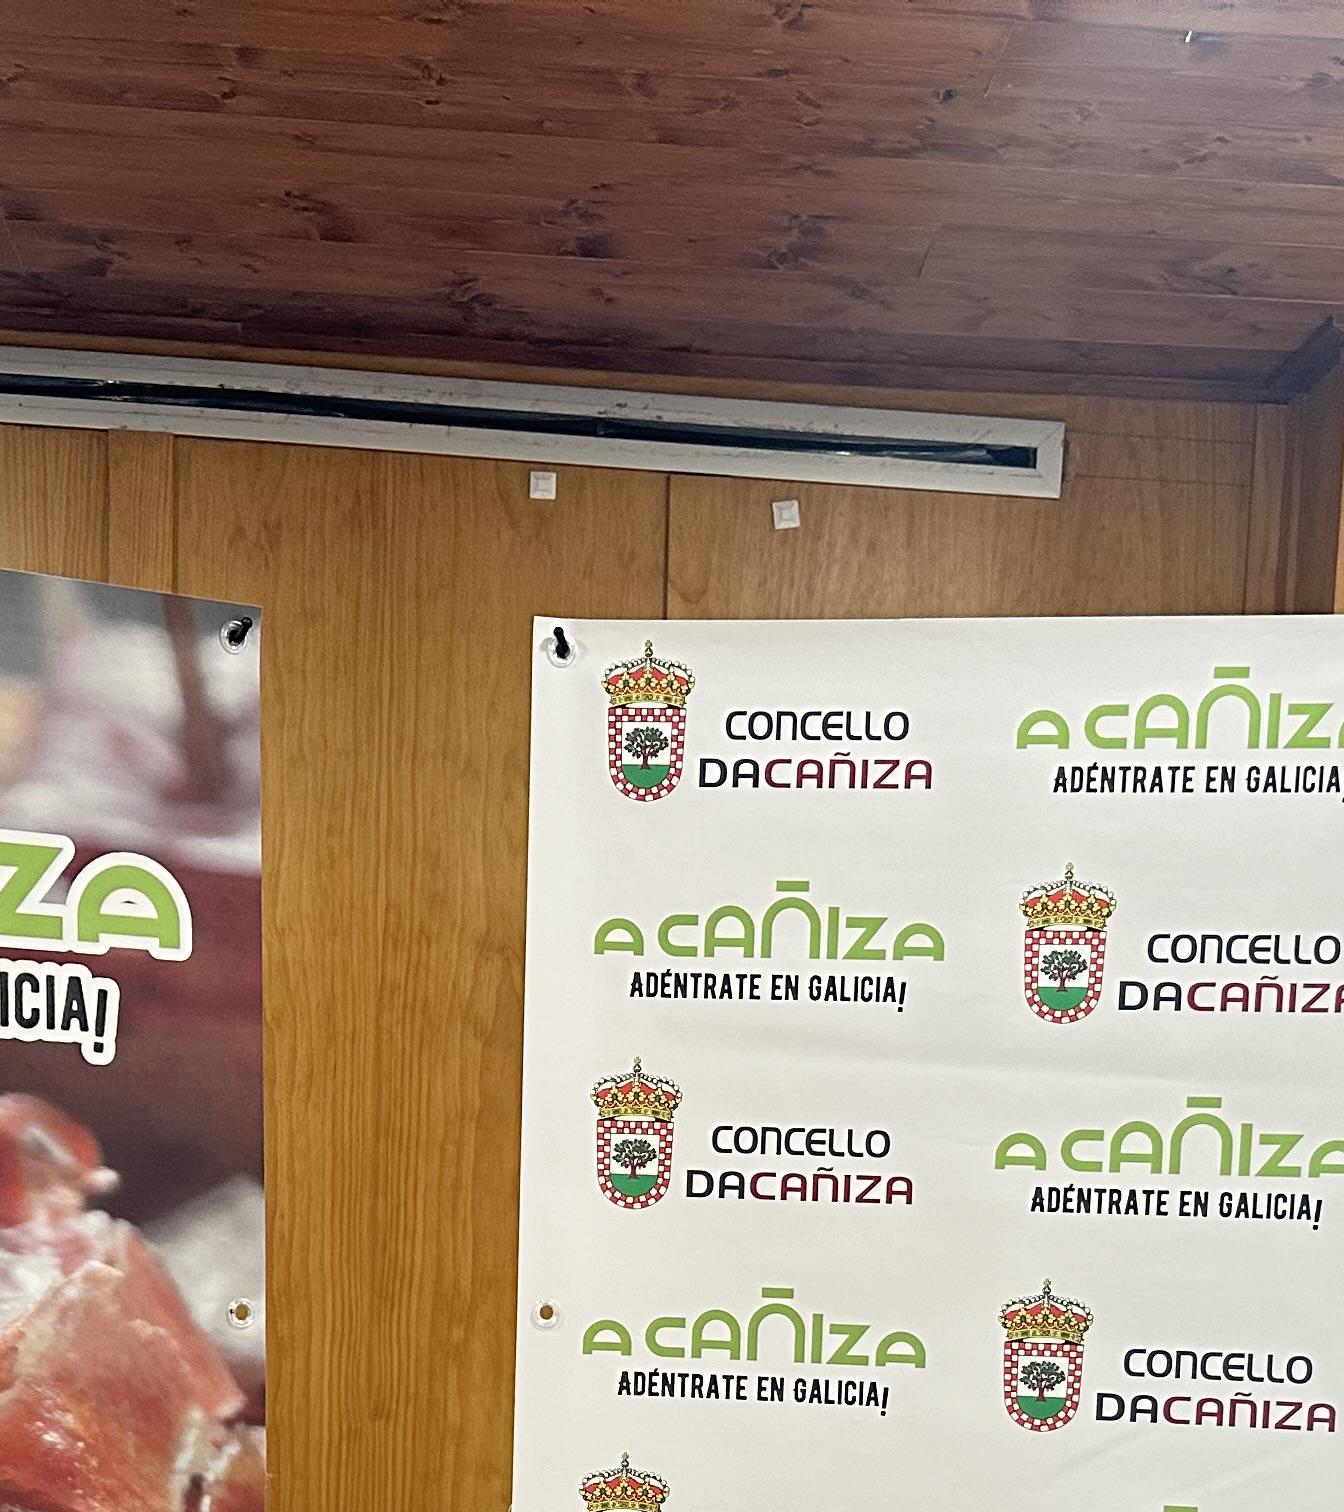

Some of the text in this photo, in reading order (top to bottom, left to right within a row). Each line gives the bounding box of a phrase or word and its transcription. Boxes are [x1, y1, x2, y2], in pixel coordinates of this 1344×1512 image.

[725, 709, 909, 742] CONCELLO
[1016, 708, 1069, 749] A
[1053, 762, 1195, 795] ADÉNTRATE
[1204, 765, 1235, 795] EN
[594, 880, 945, 962] A CAÑIZA
[1147, 933, 1342, 966] CONCELLO
[630, 968, 762, 1002] ADÉNTRATE
[770, 973, 800, 1002] EN
[711, 1125, 891, 1158] CONCELLO
[994, 1130, 1048, 1171] A
[1030, 1185, 1169, 1217] ADÉNTRATE
[1179, 1189, 1210, 1219] EN
[581, 1287, 927, 1368] A CAÑIZA
[1123, 1348, 1314, 1386] CONCELLO
[617, 1368, 751, 1403] ADÉNTRATE
[758, 1374, 786, 1403] EN
